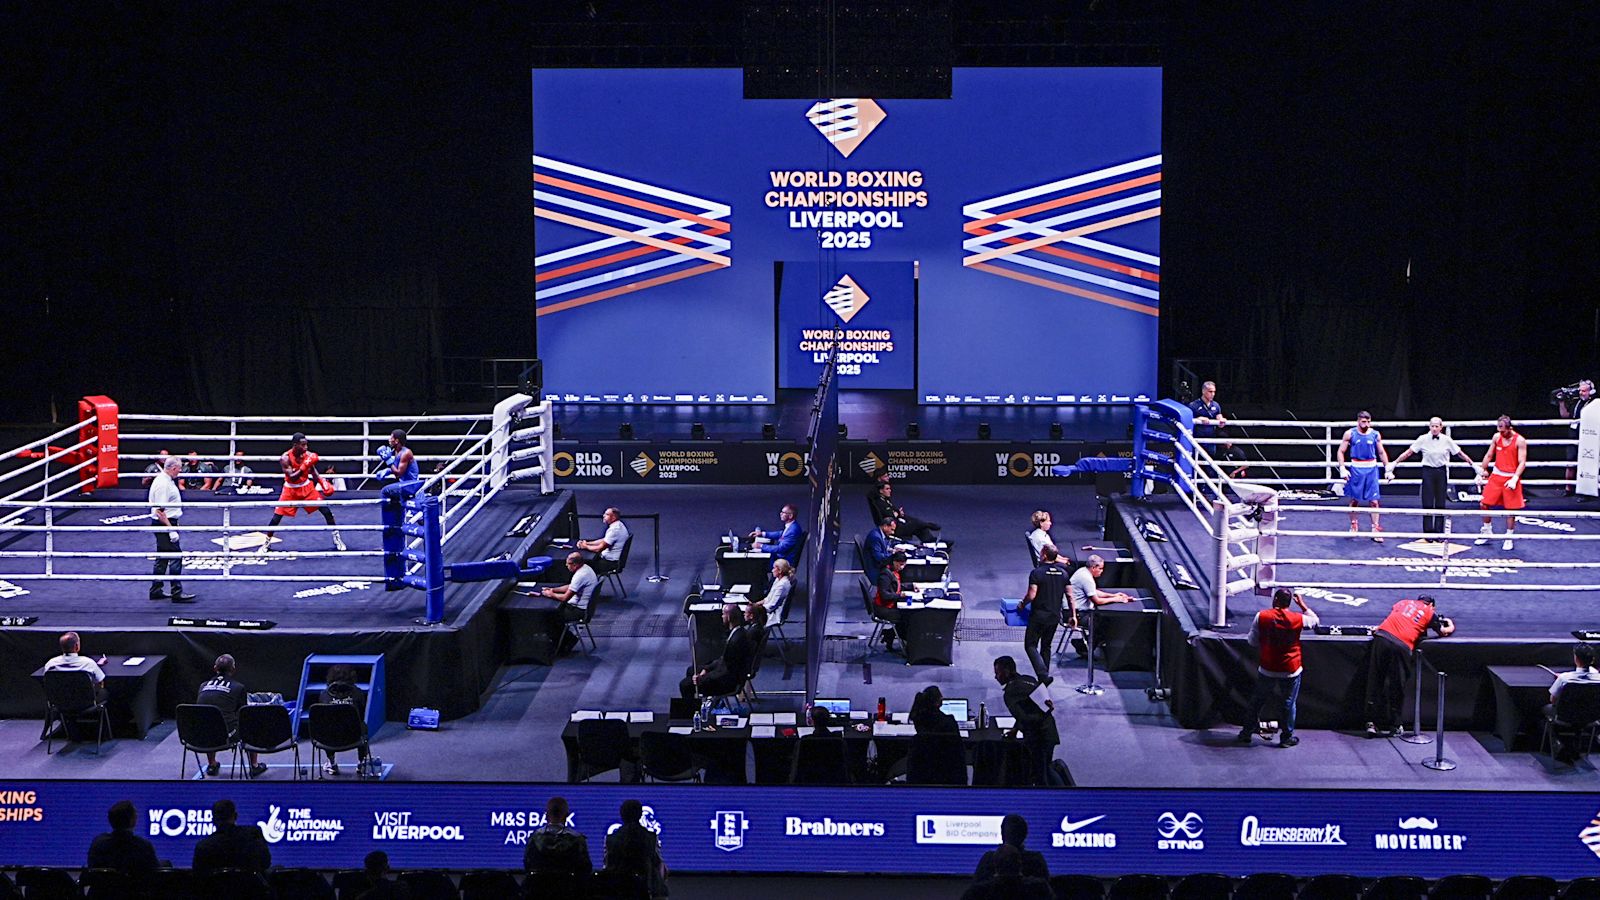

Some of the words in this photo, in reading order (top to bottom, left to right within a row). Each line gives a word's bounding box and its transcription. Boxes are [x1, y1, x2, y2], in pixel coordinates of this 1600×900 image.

[770, 171, 842, 187] WORLD
[846, 171, 923, 187] BOXING
[765, 191, 928, 207] CHAMPIONSHIPS
[790, 211, 903, 228] LIVERPOOL
[821, 231, 871, 248] 2025
[846, 330, 890, 340] BOXING
[288, 809, 311, 819] THE
[375, 812, 412, 826] VISIT
[491, 812, 526, 826] M&S
[529, 812, 575, 827] BAK
[287, 820, 344, 830] NATIONAL
[373, 825, 464, 840] LIVERPOOL
[786, 817, 885, 836] Brabners
[287, 831, 338, 841] LOTTERY
[961, 830, 998, 838] Company
[1052, 833, 1116, 848] BOXING
[1158, 840, 1204, 849] STING
[1375, 834, 1463, 850] MOVEMBER
